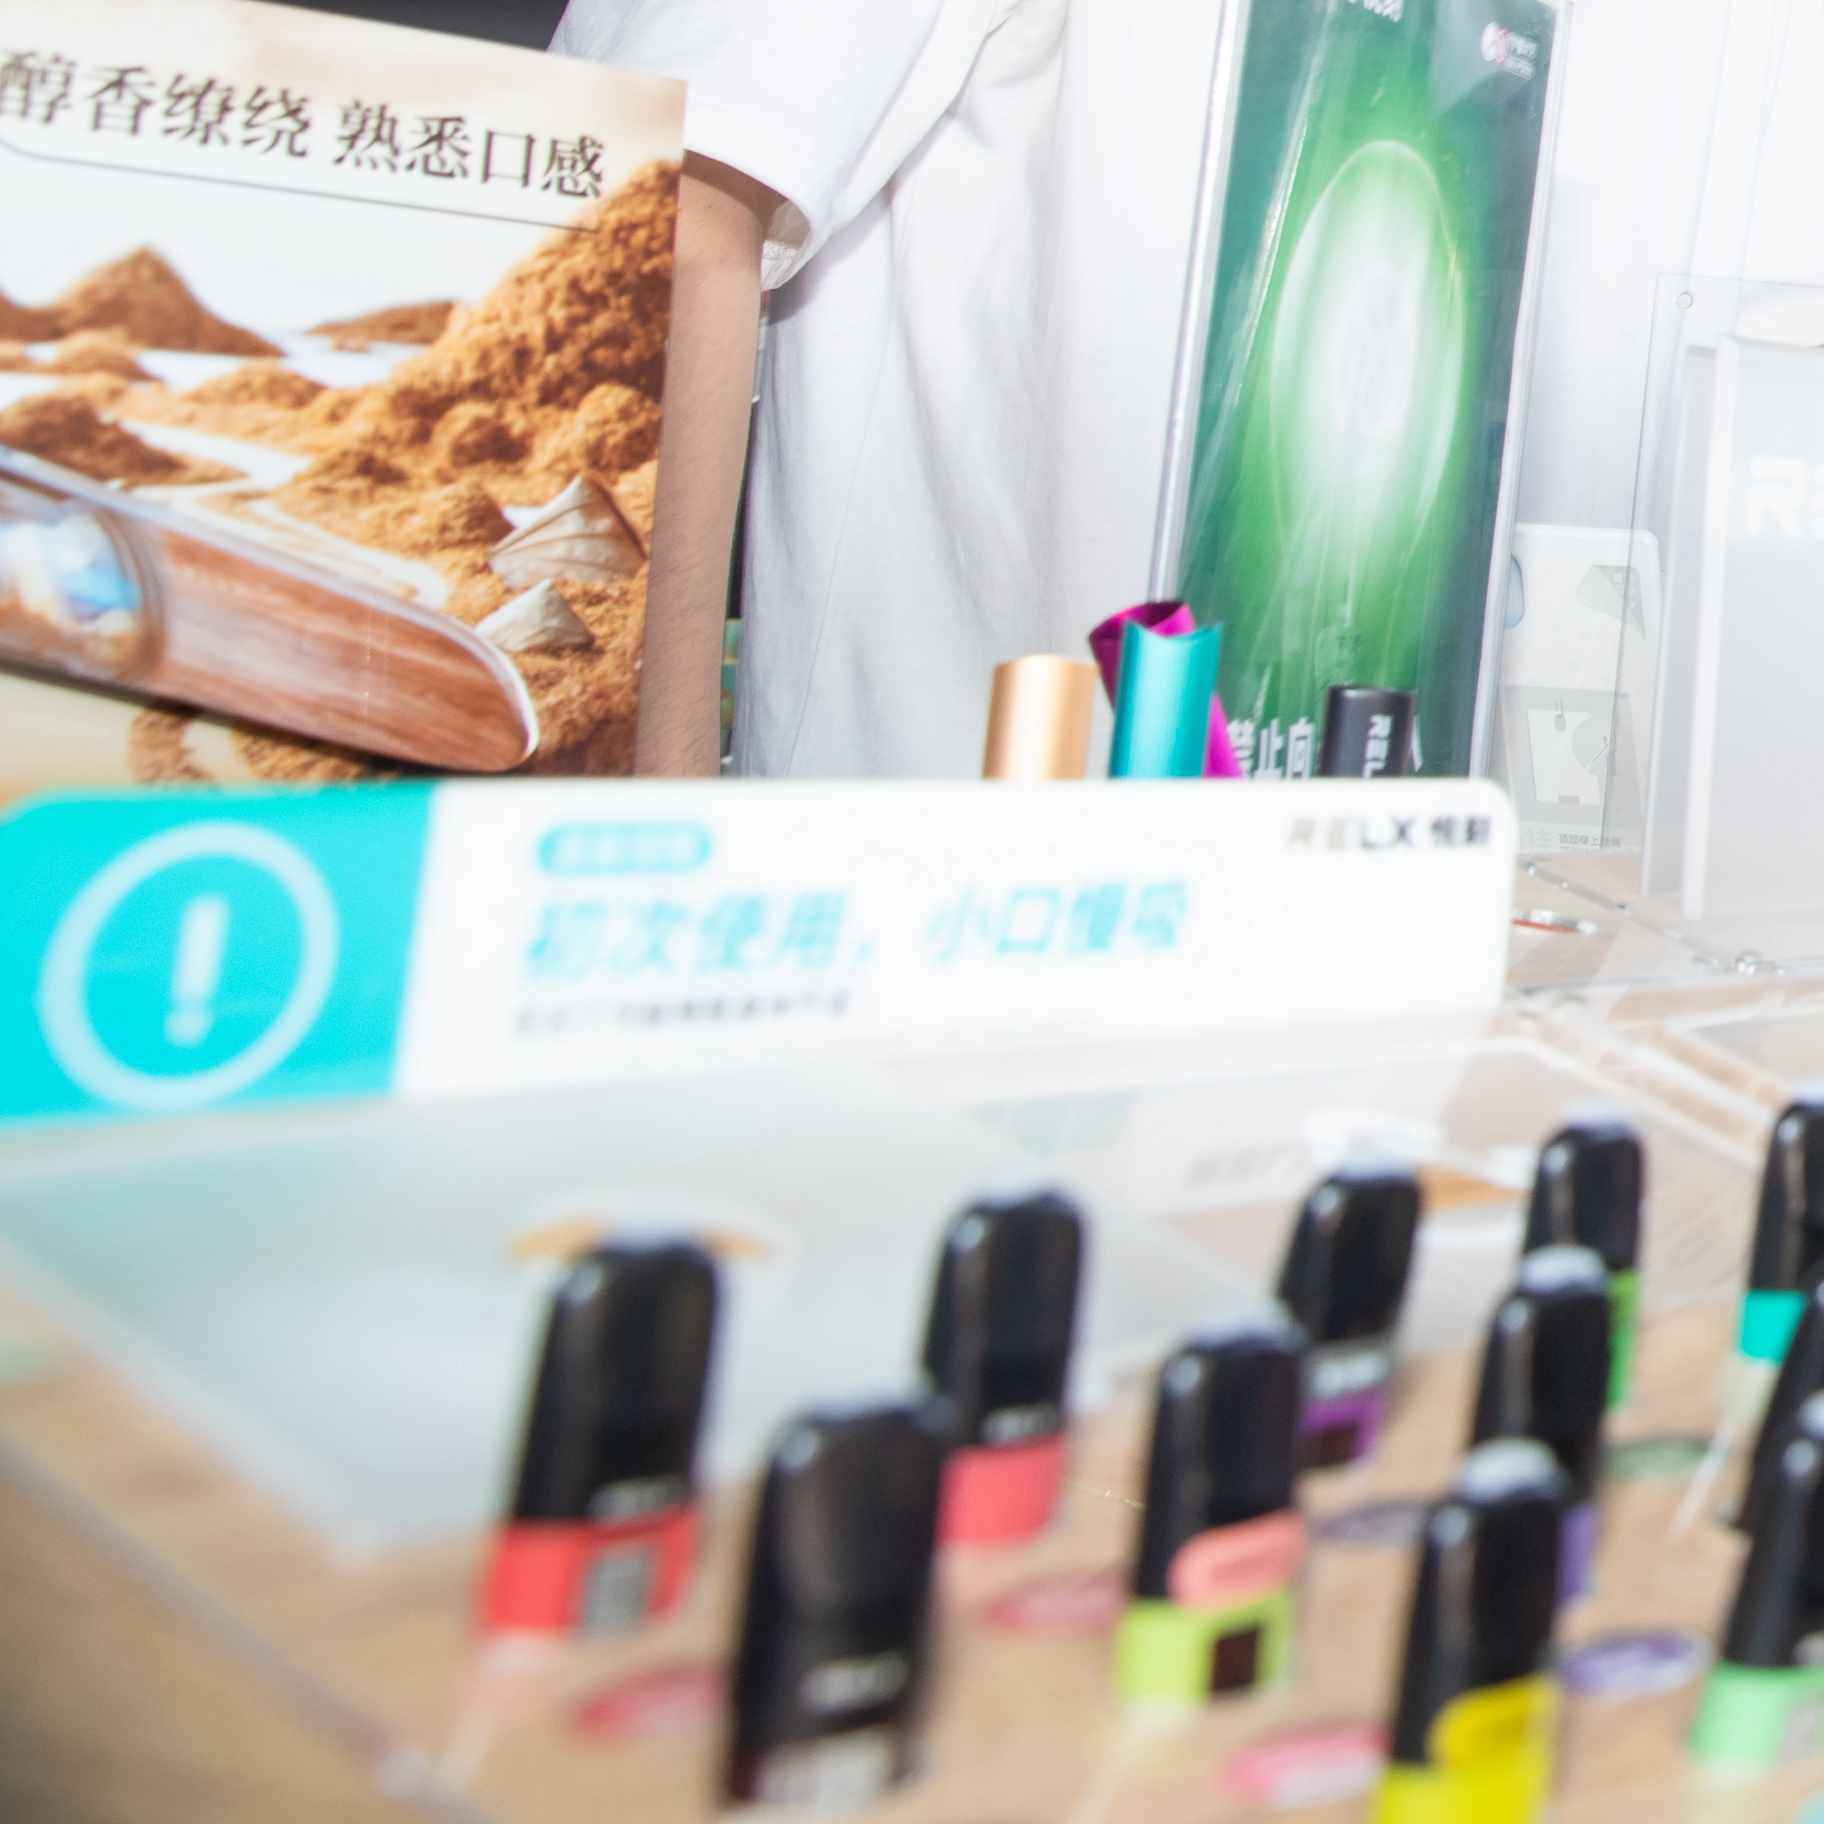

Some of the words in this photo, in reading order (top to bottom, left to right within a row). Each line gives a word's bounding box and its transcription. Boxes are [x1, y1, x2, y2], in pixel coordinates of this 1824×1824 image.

[0, 49, 312, 160] 醇香缭绕
[333, 98, 606, 199] 熟悉口感
[1360, 714, 1393, 780] REL
